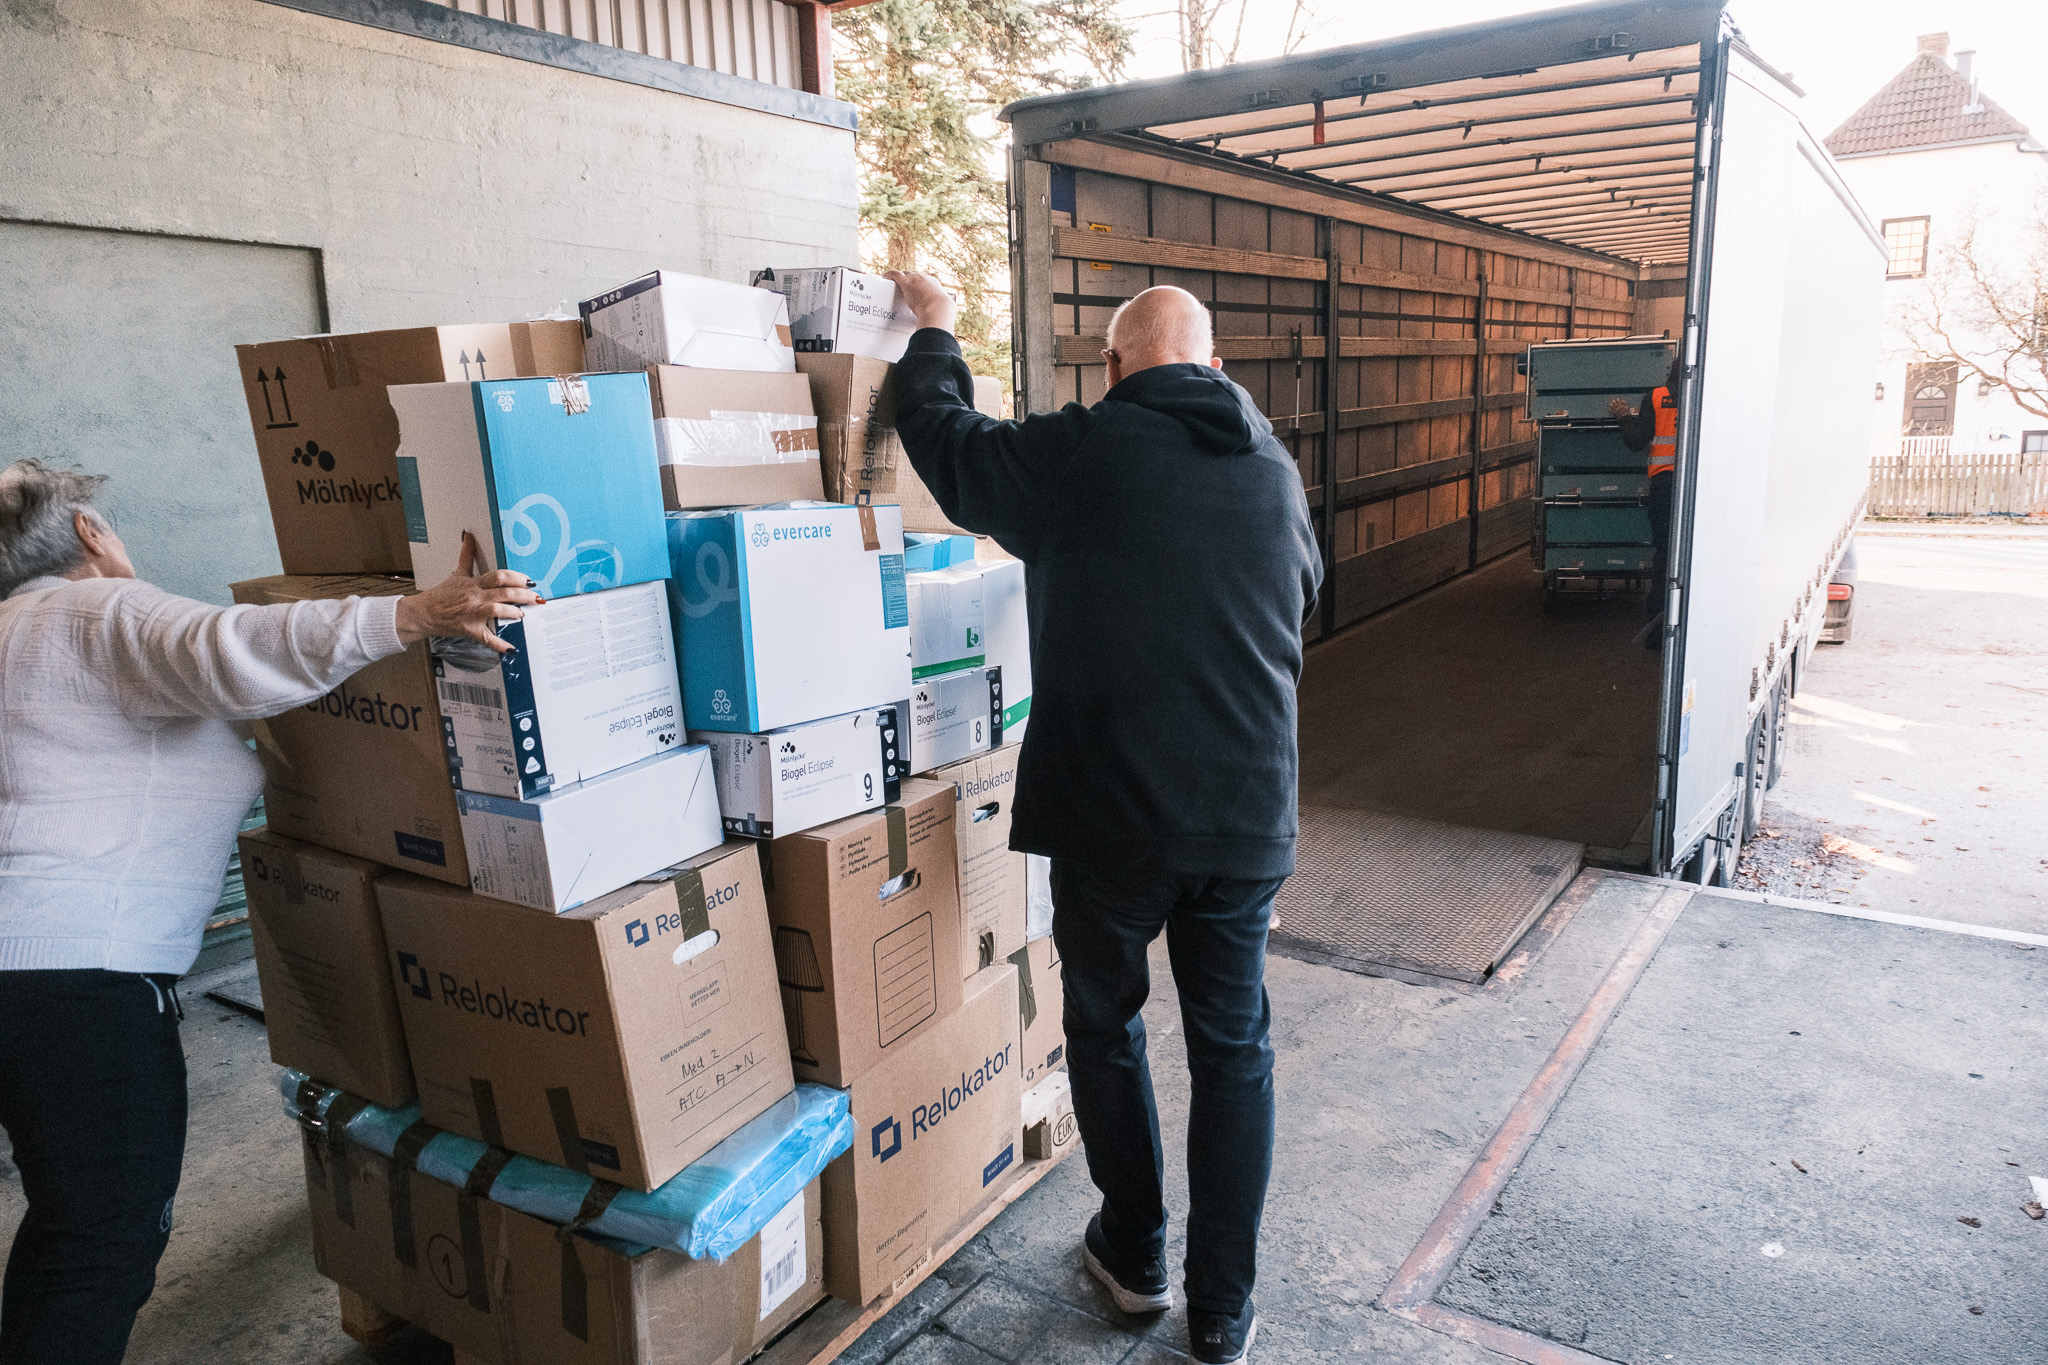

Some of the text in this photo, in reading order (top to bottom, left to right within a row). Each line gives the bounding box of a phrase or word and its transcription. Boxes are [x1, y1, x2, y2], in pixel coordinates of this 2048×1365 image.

[848, 300, 897, 321] Biogel Eclipse
[296, 475, 402, 509] Mölnlyck
[773, 524, 832, 541] evercare
[302, 683, 422, 732] lokator
[609, 705, 674, 734] Biogel Eclipse
[710, 713, 738, 722] evercare
[916, 706, 957, 726] Biogel Eclipse
[975, 720, 982, 744] 8
[781, 757, 835, 782] Biogel Eclipse
[863, 772, 873, 799] 9
[966, 769, 1015, 799] Relokator
[273, 868, 341, 904] Rkator
[656, 881, 741, 936] Reator
[439, 972, 590, 1038] Relokator
[660, 1047, 679, 1063] ESKEN
[681, 1049, 721, 1079] Med 2
[679, 1085, 707, 1111] ATC
[912, 1042, 1012, 1141] Relokator
[1057, 1115, 1073, 1143] EUR
[442, 1252, 454, 1286] 1
